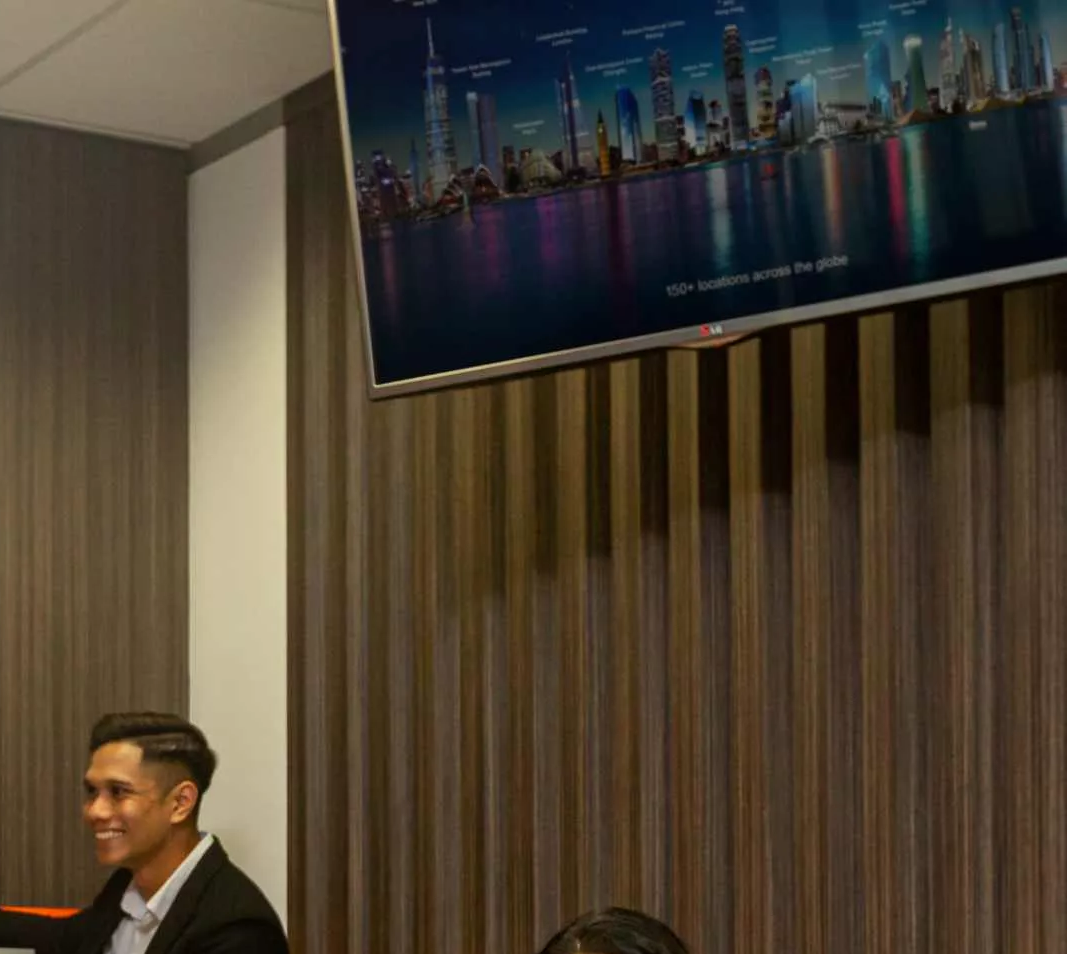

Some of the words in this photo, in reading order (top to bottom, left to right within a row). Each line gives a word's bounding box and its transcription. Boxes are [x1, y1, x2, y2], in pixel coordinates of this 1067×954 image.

[666, 282, 694, 297] 150+
[698, 273, 749, 292] locations
[752, 264, 792, 282] across
[794, 261, 813, 274] the
[816, 255, 848, 272] globe
